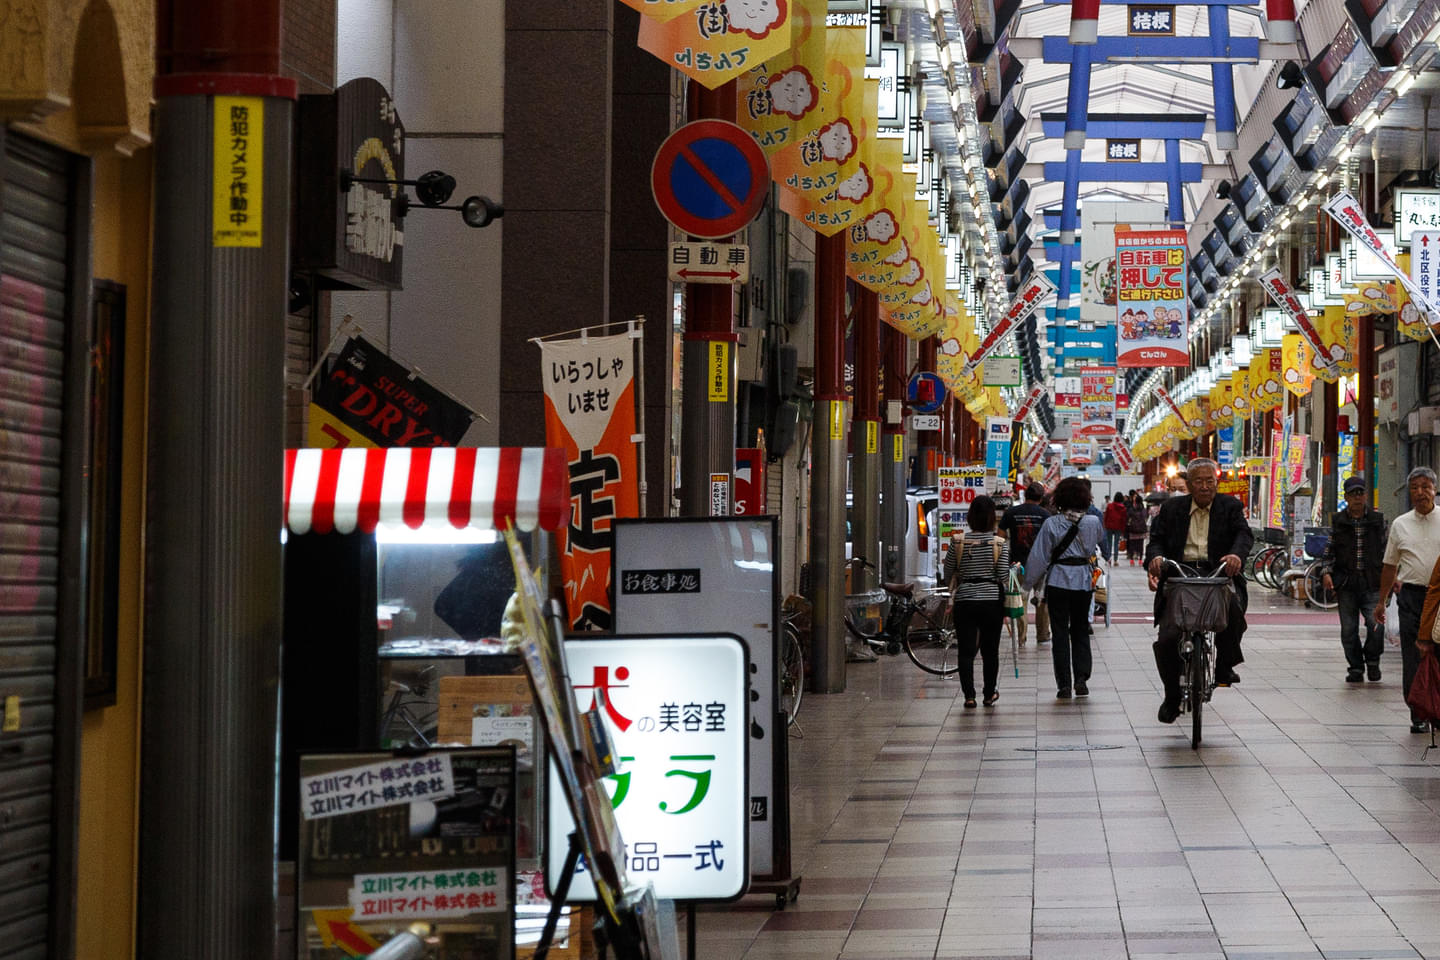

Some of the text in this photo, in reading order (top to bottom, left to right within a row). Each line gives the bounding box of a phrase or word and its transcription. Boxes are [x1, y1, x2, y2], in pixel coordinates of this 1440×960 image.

[1132, 10, 1171, 32] 桔梗
[229, 105, 249, 227] 防犯カメラ作動中
[672, 245, 746, 265] 自動車
[1120, 248, 1185, 266] 自転車は
[1120, 267, 1182, 289] 押して
[552, 356, 624, 384] いらっしゃ
[373, 375, 430, 417] SUPER
[568, 389, 610, 413] いませ
[914, 417, 939, 428] 7-22
[624, 572, 698, 592] お食事処
[307, 757, 443, 797] 立川マイト株式会社
[309, 776, 445, 817] 立川マイト株式会社
[361, 870, 498, 895] 立川マイト株式会社
[361, 891, 498, 916] 立川マイト株式会社
